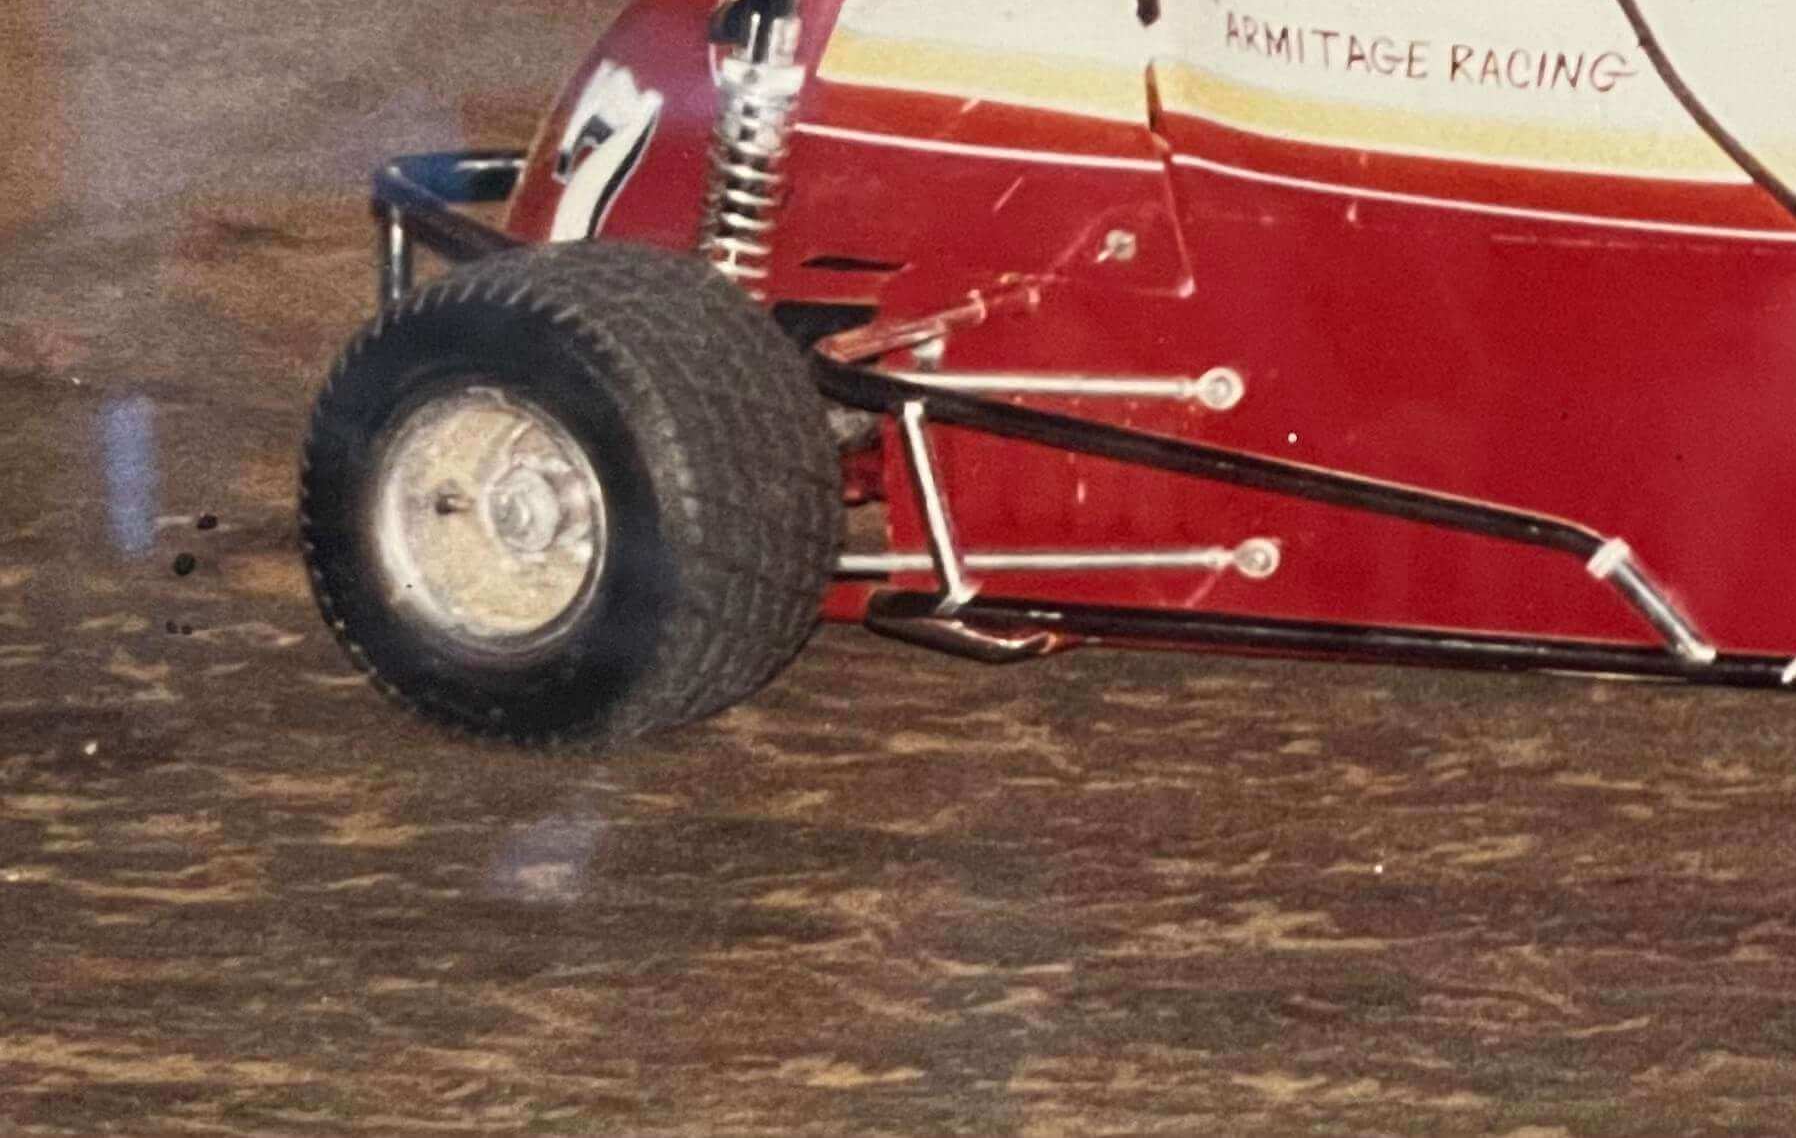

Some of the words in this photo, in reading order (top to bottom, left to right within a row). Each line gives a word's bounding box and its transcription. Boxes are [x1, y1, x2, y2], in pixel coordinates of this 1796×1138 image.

[1225, 10, 1431, 79] ARMITAGE
[1449, 44, 1640, 93] RACING
[550, 58, 665, 244] 7
